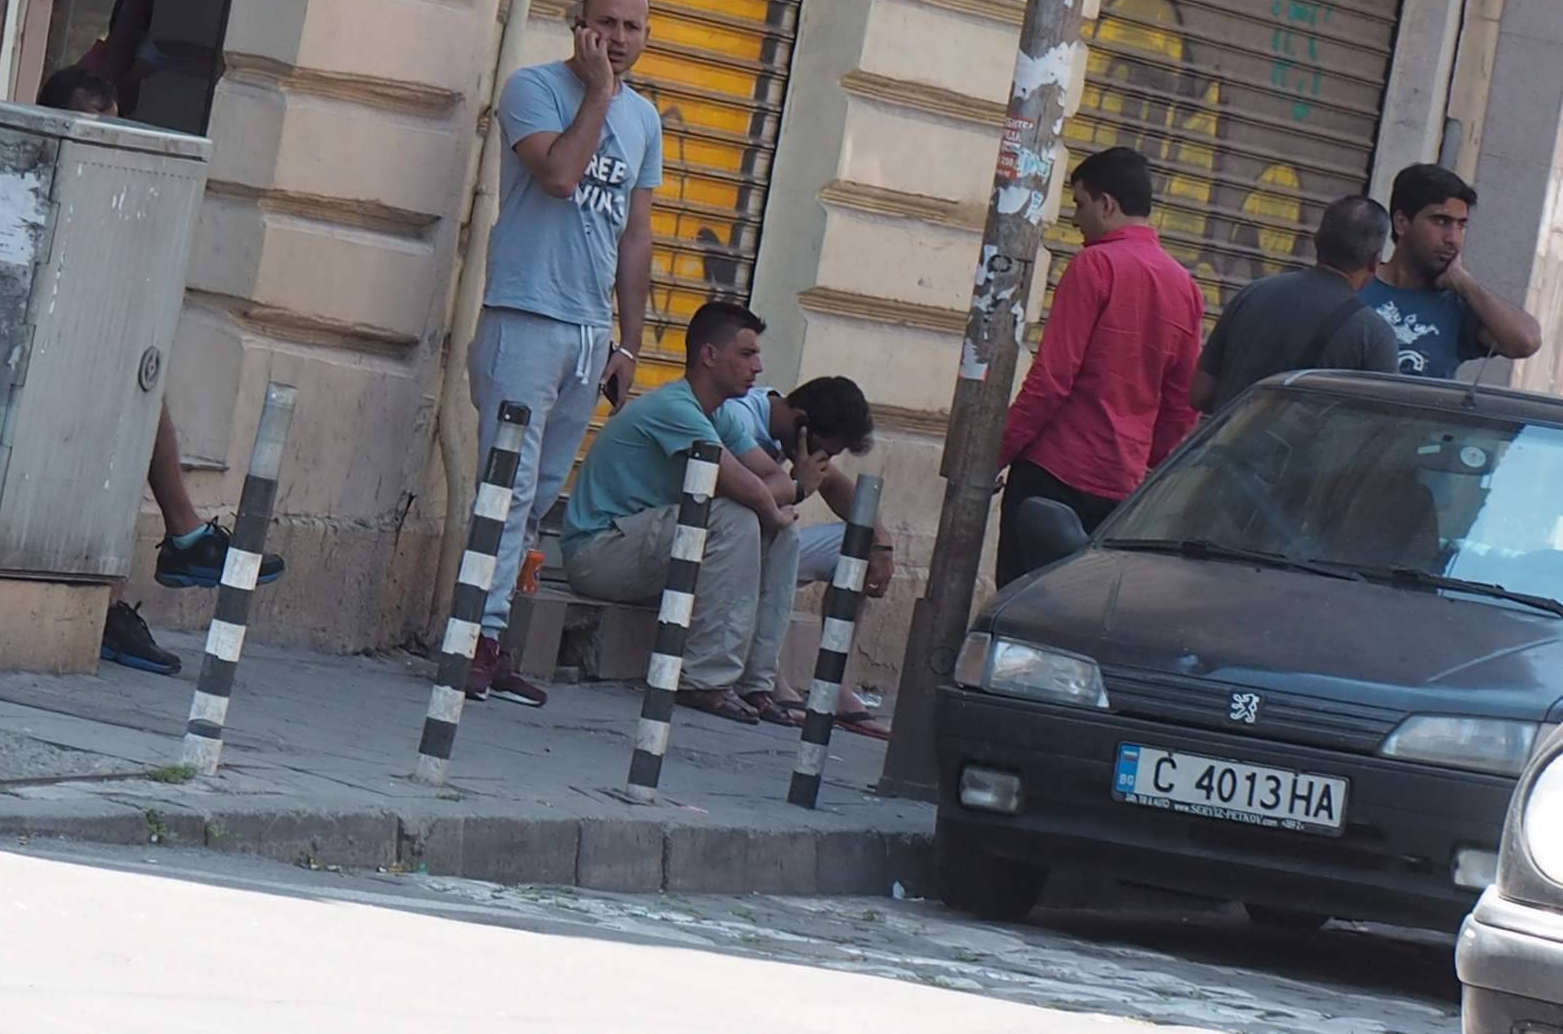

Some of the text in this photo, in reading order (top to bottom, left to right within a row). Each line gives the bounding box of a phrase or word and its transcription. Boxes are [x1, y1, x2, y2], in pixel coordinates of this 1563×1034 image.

[584, 153, 628, 184] REE
[1119, 772, 1136, 787] BG
[1152, 756, 1335, 821] C 4013 HA
